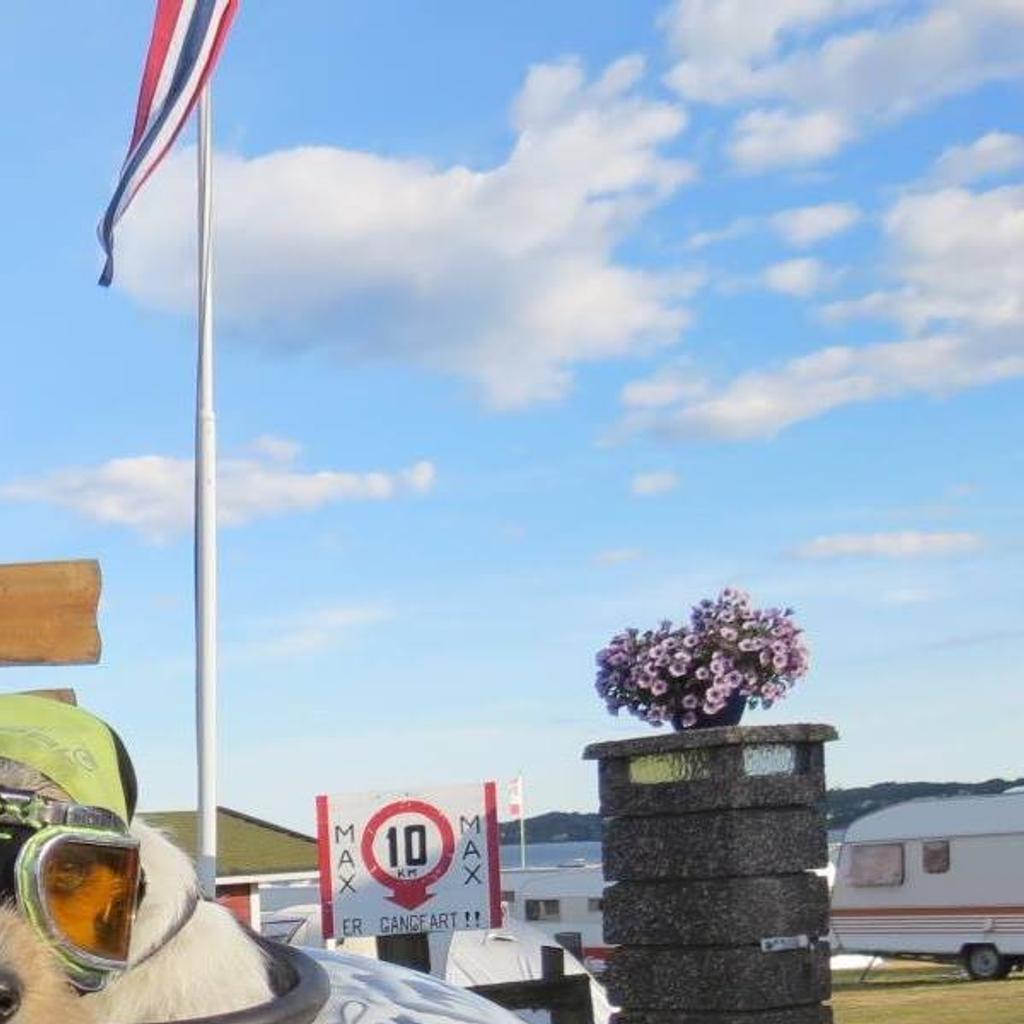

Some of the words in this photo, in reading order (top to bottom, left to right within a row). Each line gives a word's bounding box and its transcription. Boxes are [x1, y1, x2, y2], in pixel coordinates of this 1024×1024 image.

[335, 823, 356, 893] MAX
[385, 824, 427, 868] 10
[460, 814, 481, 885] MAX
[342, 917, 363, 936] ER
